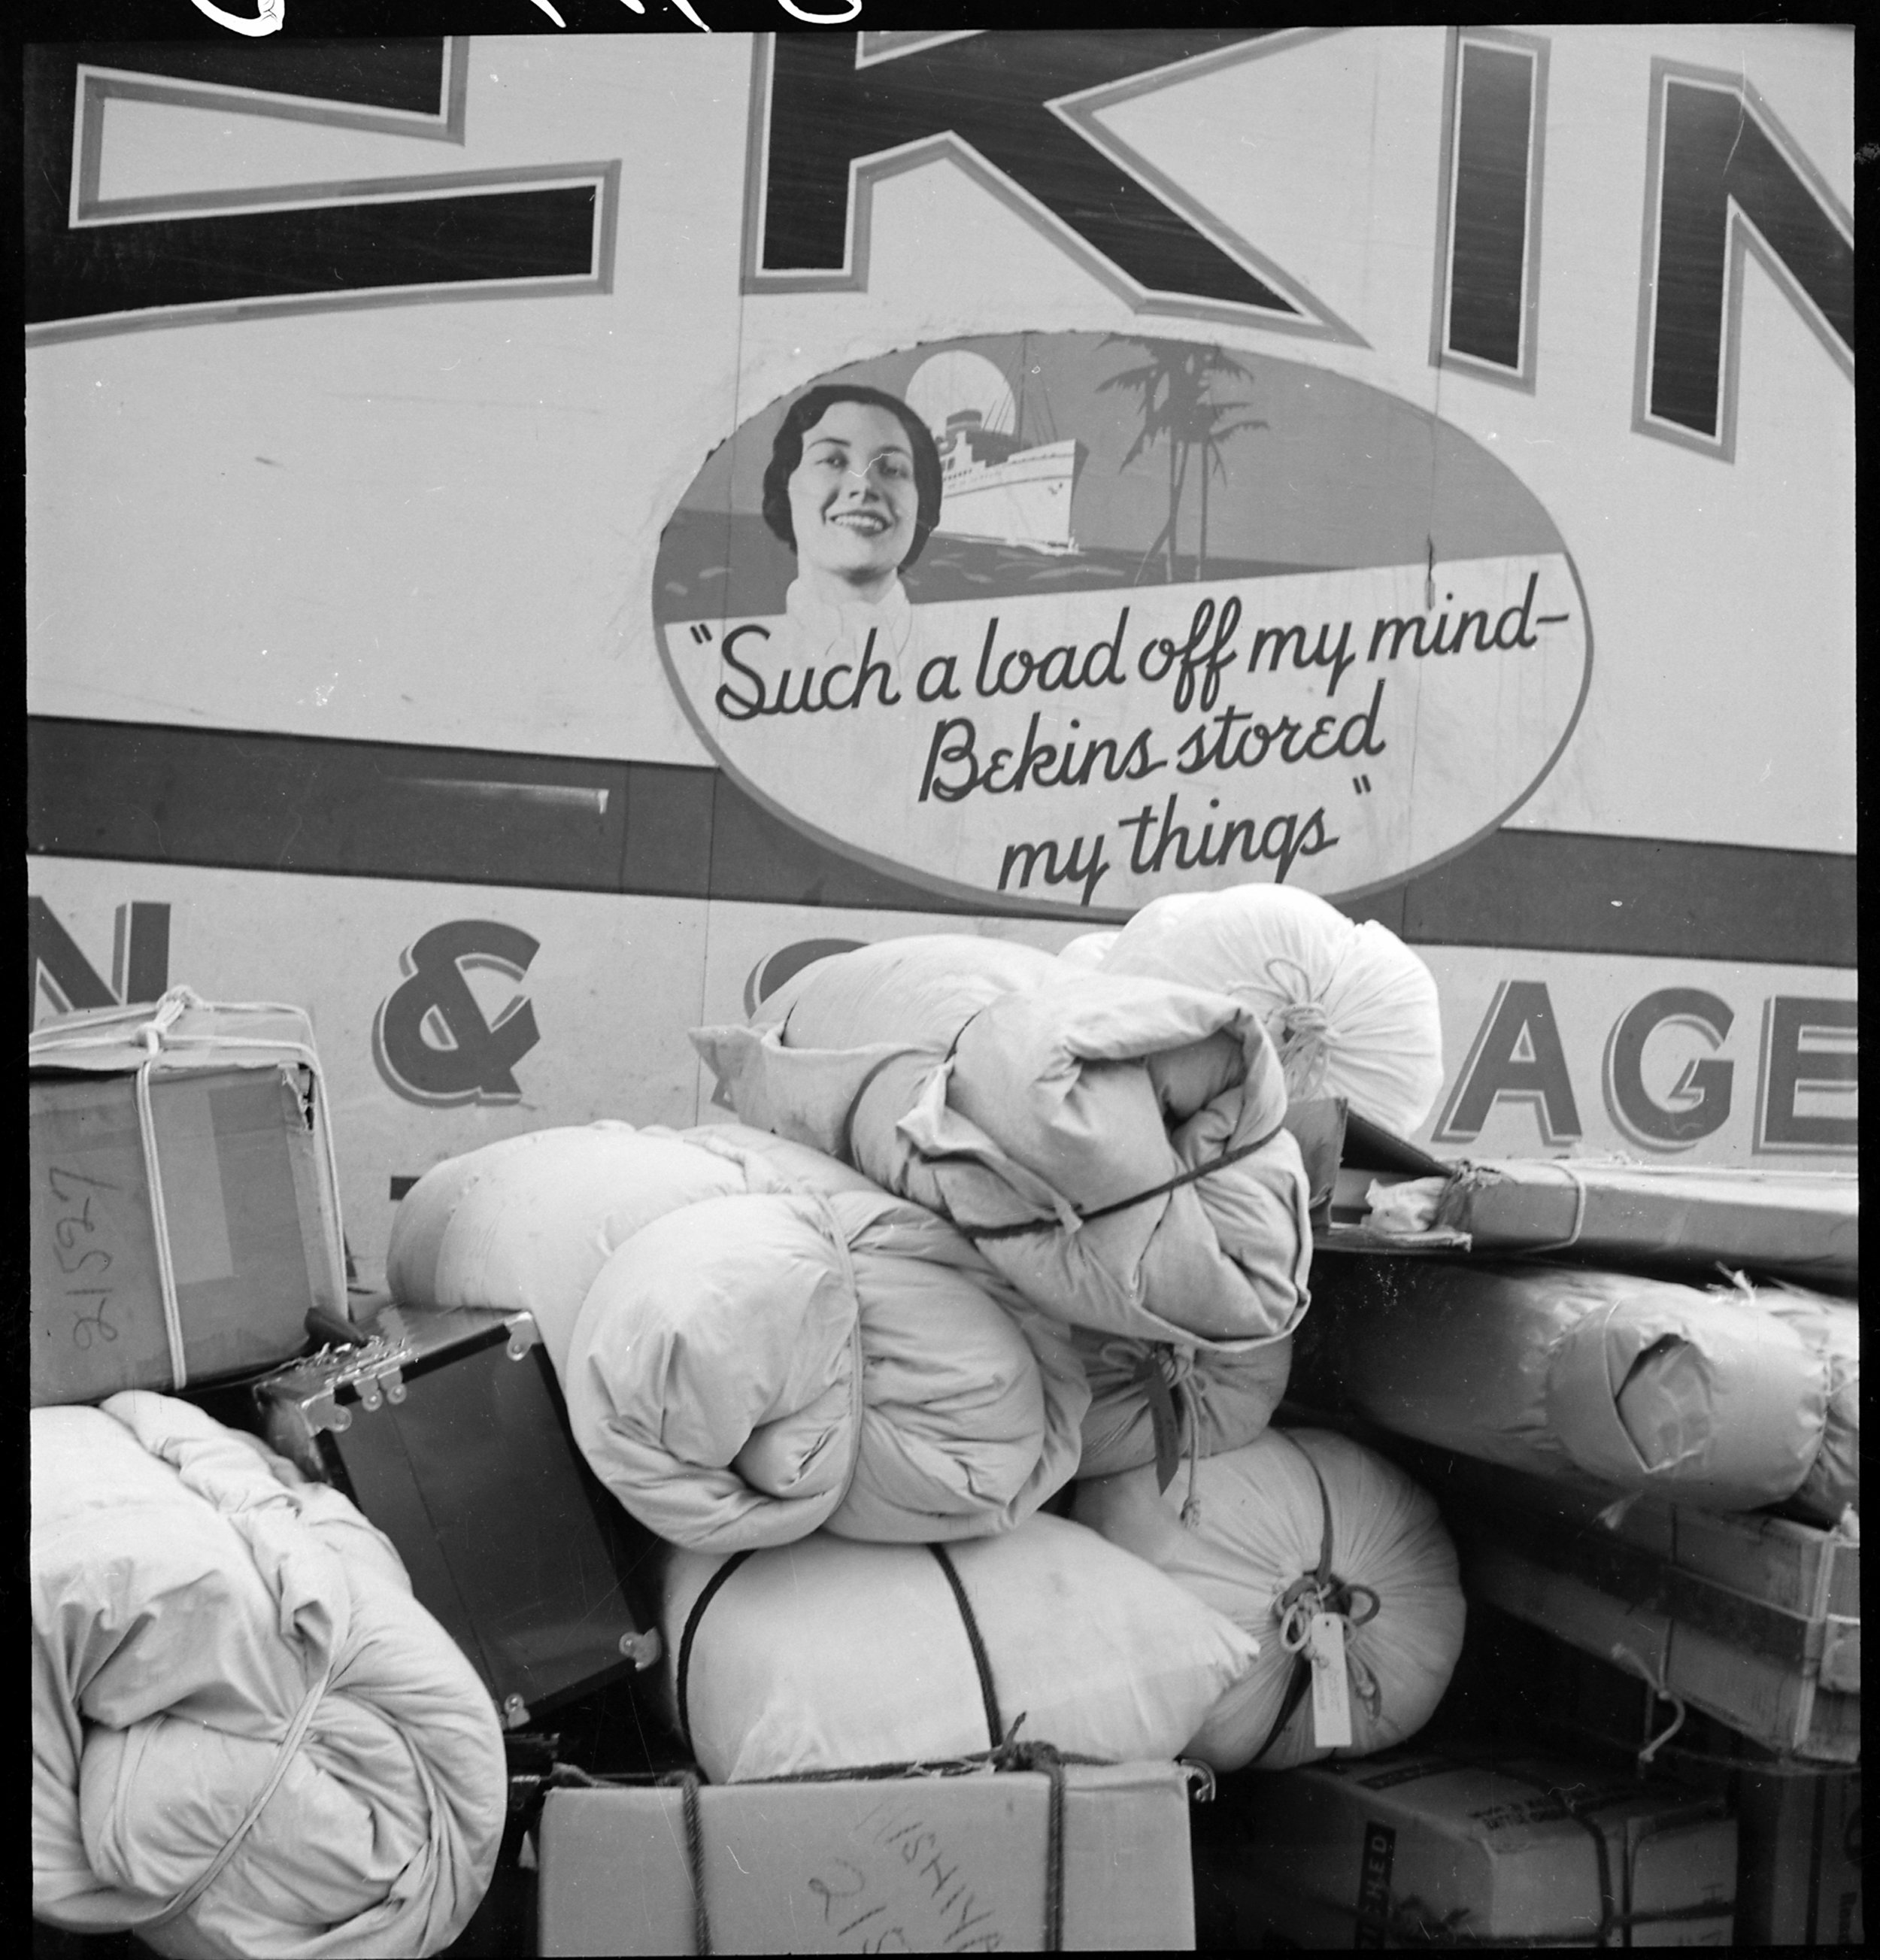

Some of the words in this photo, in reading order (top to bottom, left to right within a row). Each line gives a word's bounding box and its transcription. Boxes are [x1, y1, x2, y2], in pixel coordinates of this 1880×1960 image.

[690, 623, 902, 721] "Such
[917, 655, 962, 702] a
[975, 607, 1130, 697] load
[1138, 596, 1242, 713] off
[1248, 621, 1356, 697] my
[918, 711, 1168, 803] Bekins
[1175, 678, 1387, 775] stored
[997, 834, 1111, 908] my
[1117, 774, 1372, 884] things"
[371, 918, 541, 1109] &
[48, 1167, 120, 1352] 21527
